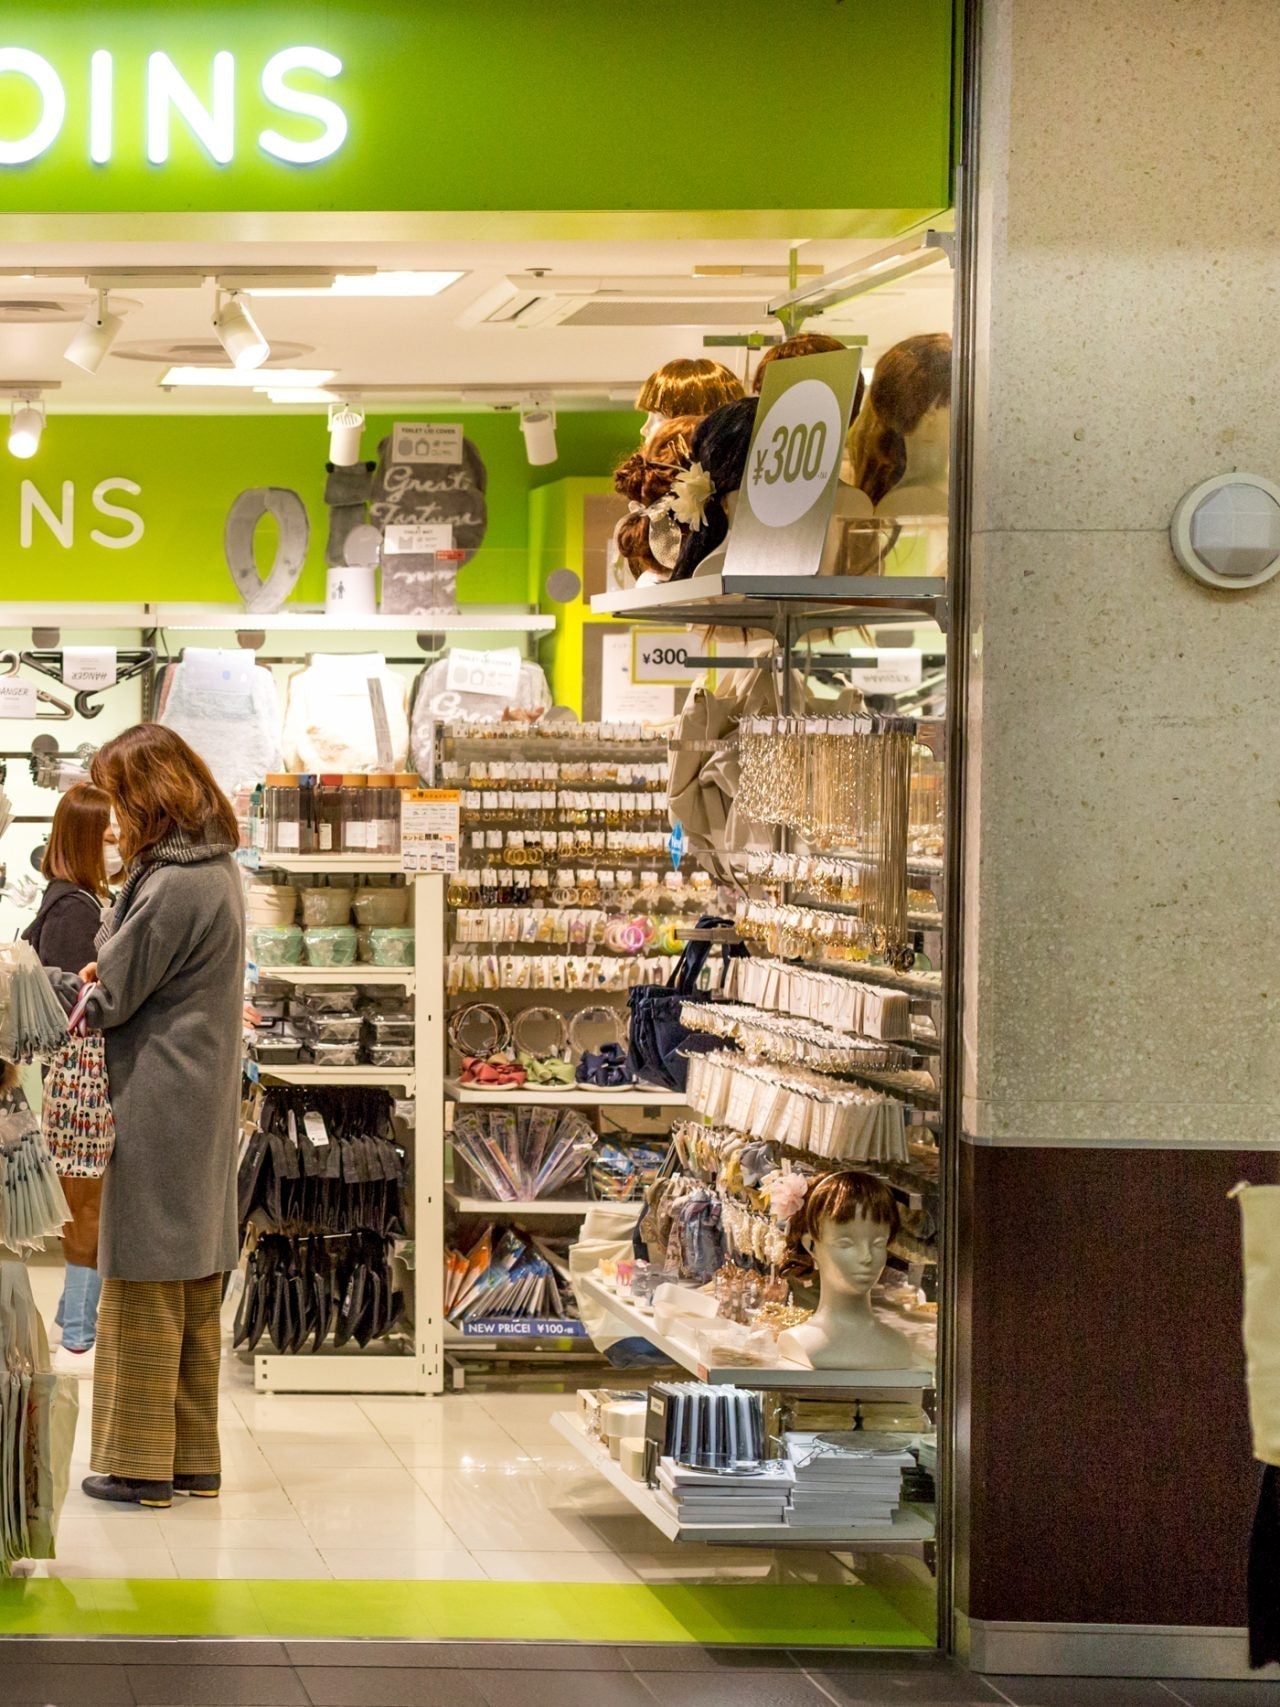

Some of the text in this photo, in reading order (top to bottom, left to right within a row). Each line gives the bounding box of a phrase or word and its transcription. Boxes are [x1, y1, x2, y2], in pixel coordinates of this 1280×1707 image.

[752, 421, 827, 486] ¥300
[643, 648, 687, 665] ¥300
[468, 1323, 495, 1333] NEW
[498, 1323, 531, 1333] PRICE!
